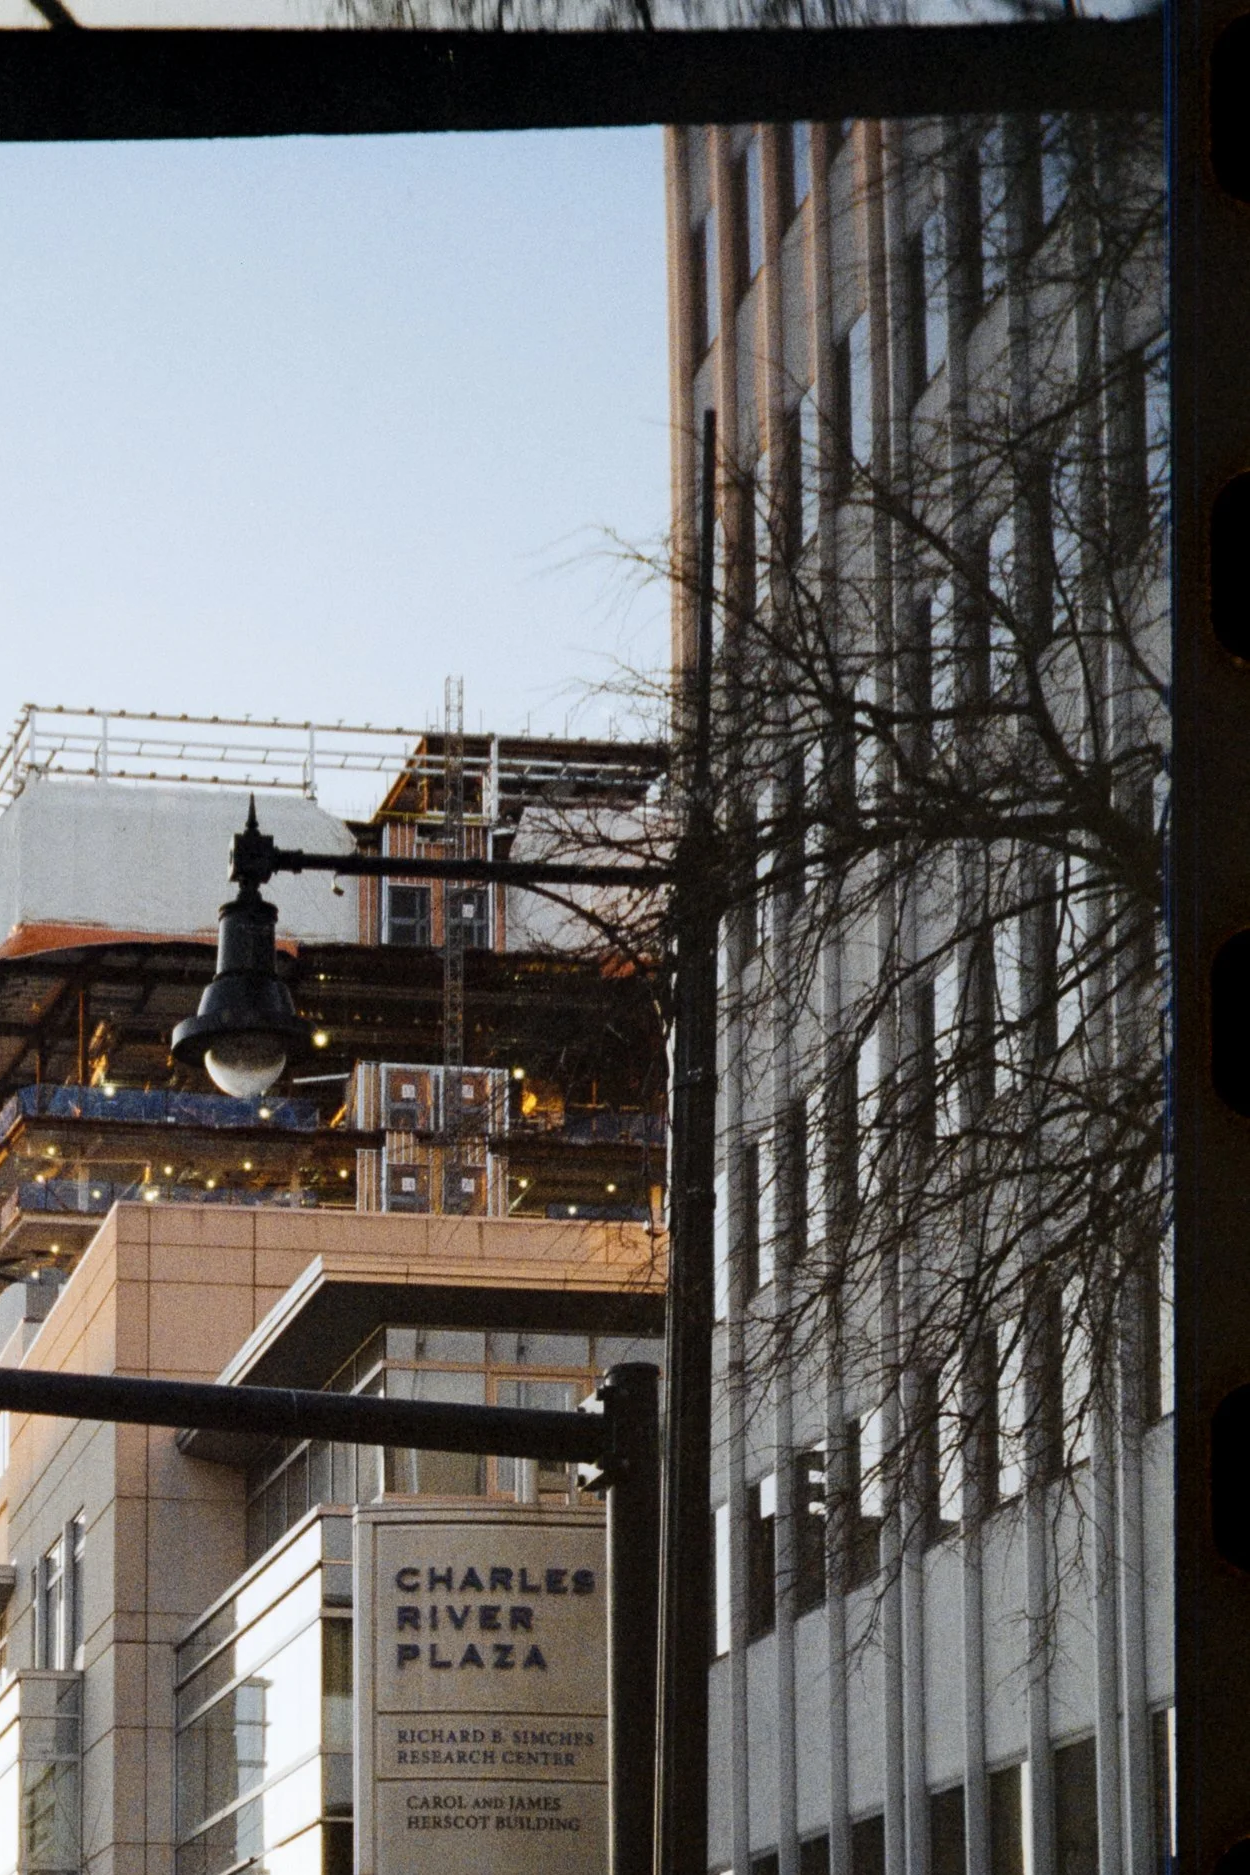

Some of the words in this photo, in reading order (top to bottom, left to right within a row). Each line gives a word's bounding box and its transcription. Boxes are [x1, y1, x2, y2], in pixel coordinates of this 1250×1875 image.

[396, 1567, 595, 1594] CHARLES
[397, 1605, 534, 1631] RIVER
[397, 1643, 548, 1670] PLAZA
[398, 1729, 485, 1744] RICHARD
[397, 1750, 496, 1765] RESEARCH
[501, 1751, 576, 1766] CENTER
[406, 1795, 467, 1810] CAROL
[509, 1796, 562, 1811] JAMES
[407, 1815, 490, 1830] HERSCOT
[496, 1816, 580, 1832] BUILDING
